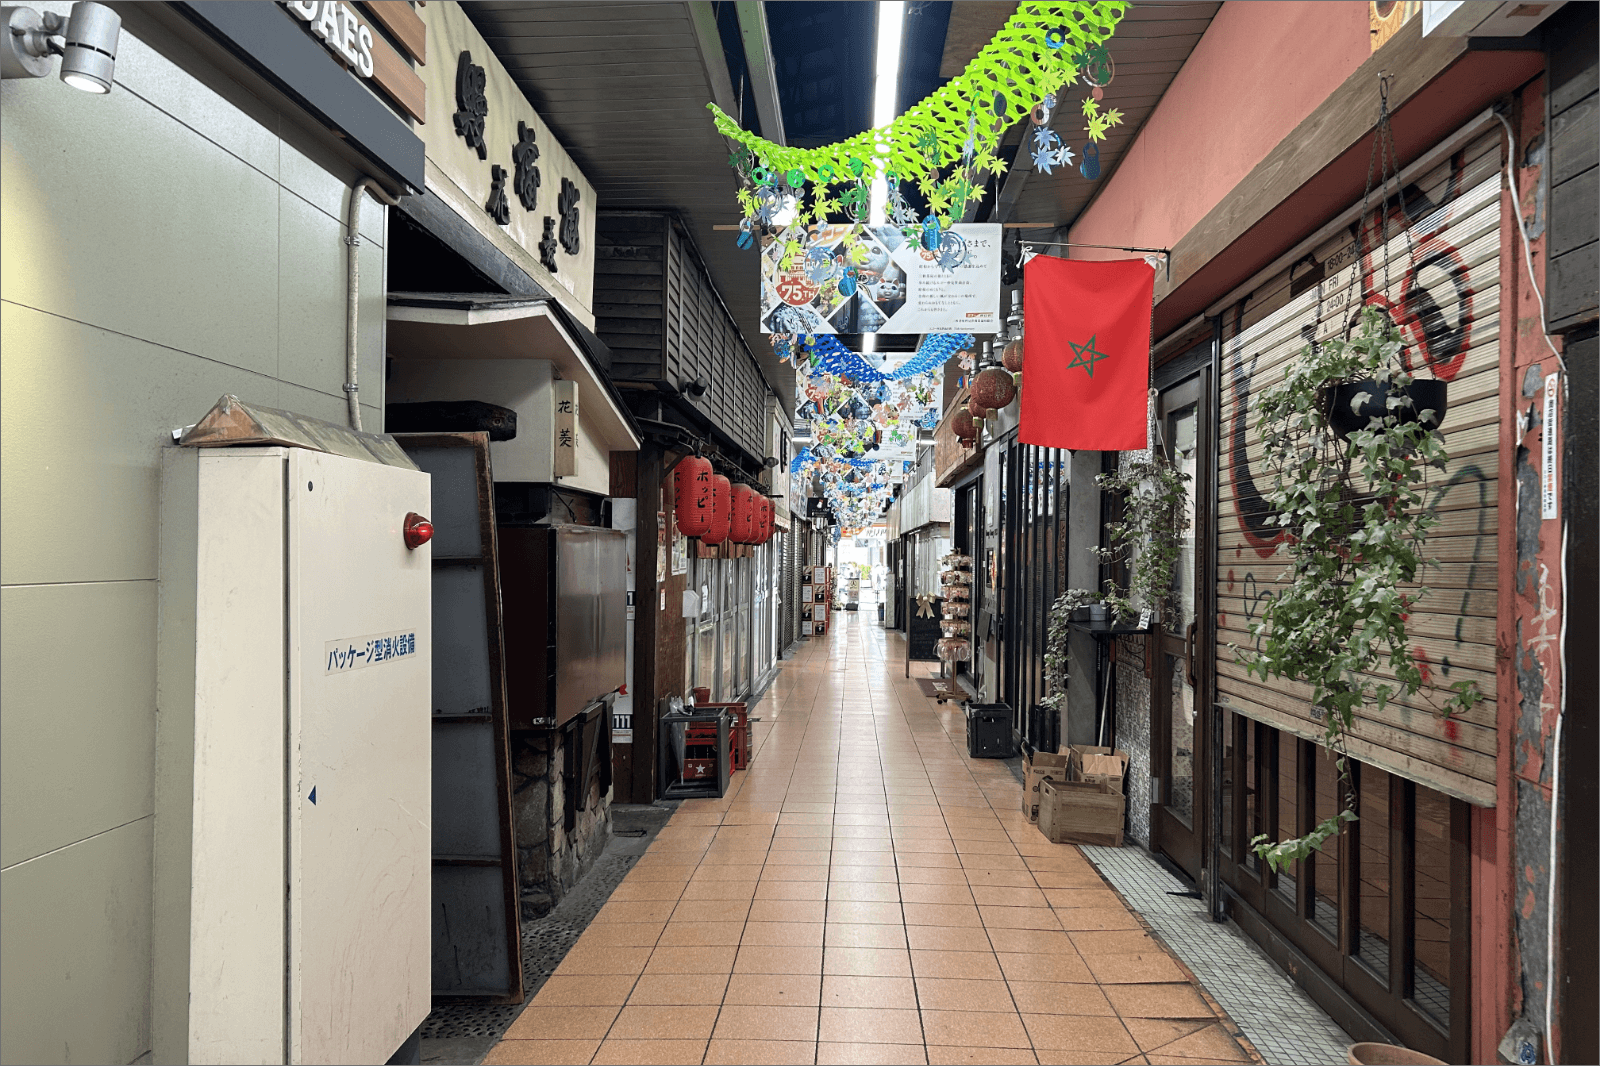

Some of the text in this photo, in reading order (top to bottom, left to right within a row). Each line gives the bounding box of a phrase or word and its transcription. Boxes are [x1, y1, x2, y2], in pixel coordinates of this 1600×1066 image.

[557, 400, 573, 448] 花菱
[697, 471, 709, 523] ホッピー
[327, 632, 415, 671] パッケージ型消火設備
